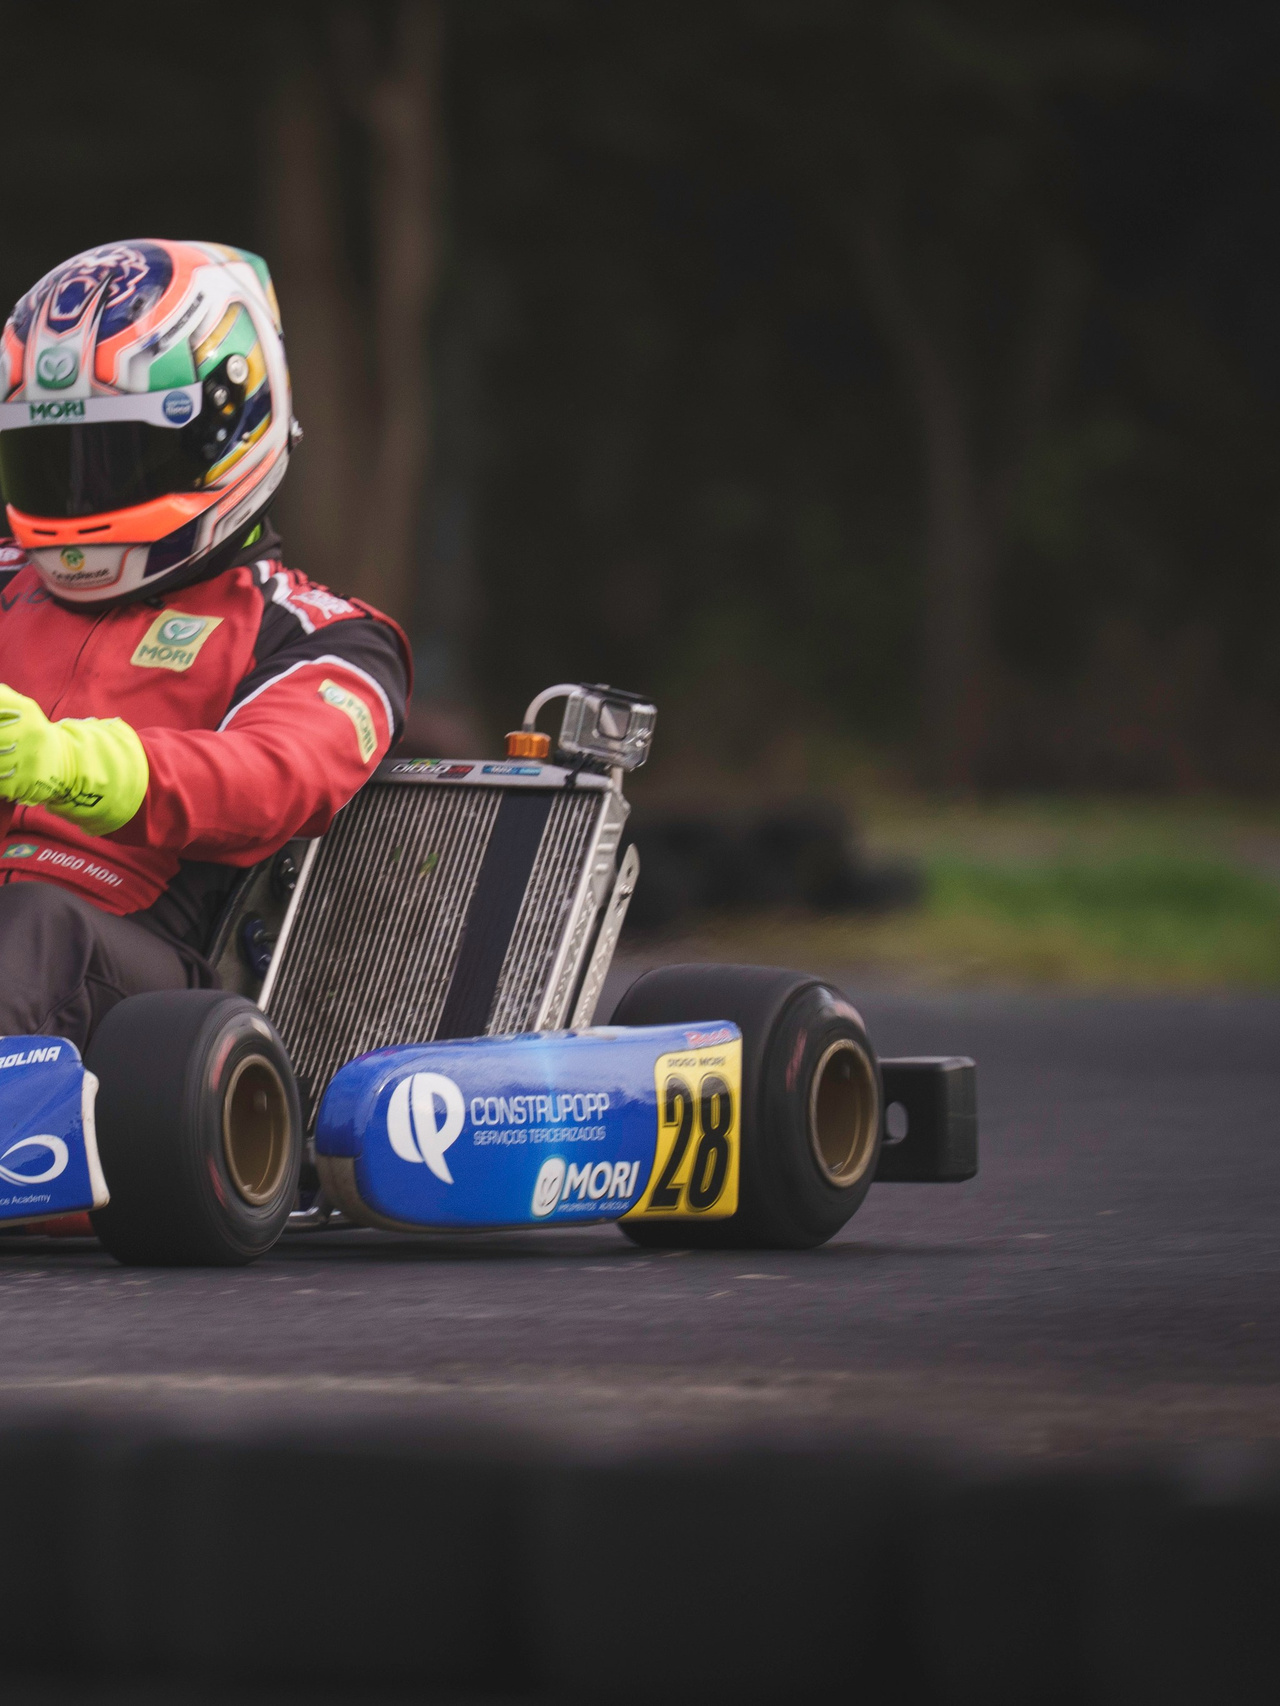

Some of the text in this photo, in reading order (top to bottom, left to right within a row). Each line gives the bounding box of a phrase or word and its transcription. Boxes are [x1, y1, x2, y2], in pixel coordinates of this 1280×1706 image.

[29, 400, 85, 419] MORI
[138, 645, 194, 666] MORI
[36, 848, 124, 888] DIOGO MORI
[698, 1056, 726, 1067] MORI
[470, 1092, 611, 1126] CONSTRUPOPP
[473, 1125, 607, 1147] SERVIÇOS TERCEIRIZADOS
[645, 1071, 734, 1213] 28
[561, 1161, 641, 1201] MORI
[10, 1194, 52, 1205] Academy
